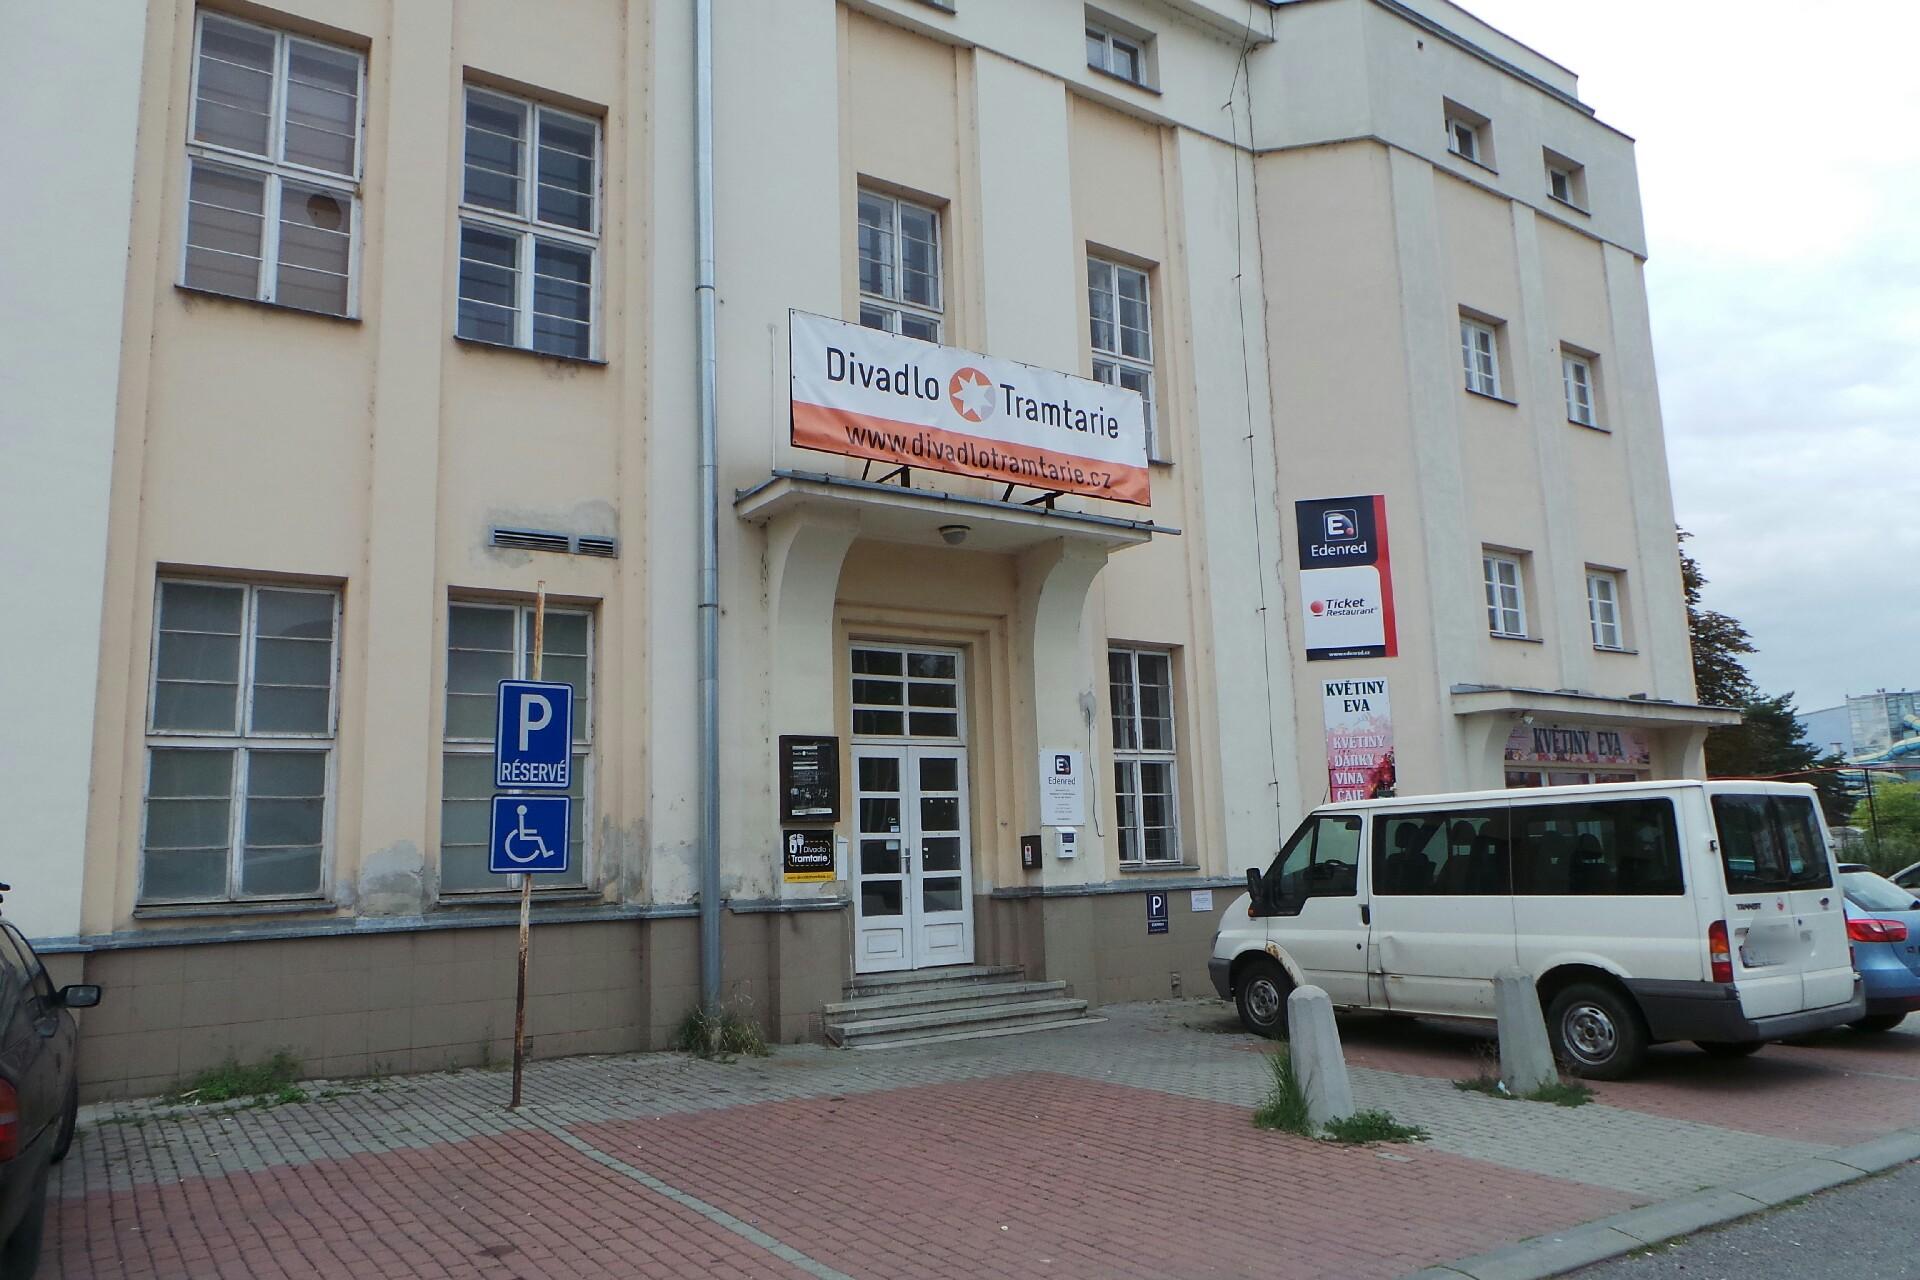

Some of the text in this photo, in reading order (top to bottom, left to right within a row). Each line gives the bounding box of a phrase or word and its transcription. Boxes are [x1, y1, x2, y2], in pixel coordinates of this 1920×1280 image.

[826, 346, 1119, 439] Divadlo Tramtarie
[845, 422, 1111, 489] www.divadlotramtarie.cz
[1311, 541, 1367, 557] Edenred
[1326, 598, 1365, 609] Ticket
[1326, 608, 1374, 617] Restaurant
[1326, 680, 1384, 696] KVĚTINY
[1344, 699, 1370, 712] EVA
[519, 694, 553, 751] P
[1533, 725, 1623, 756] KVĚTINY EVA
[501, 759, 566, 782] RÉSERVÉ
[1048, 777, 1076, 785] Edenred
[791, 854, 828, 863] Tramtarie
[1152, 896, 1162, 915] P
